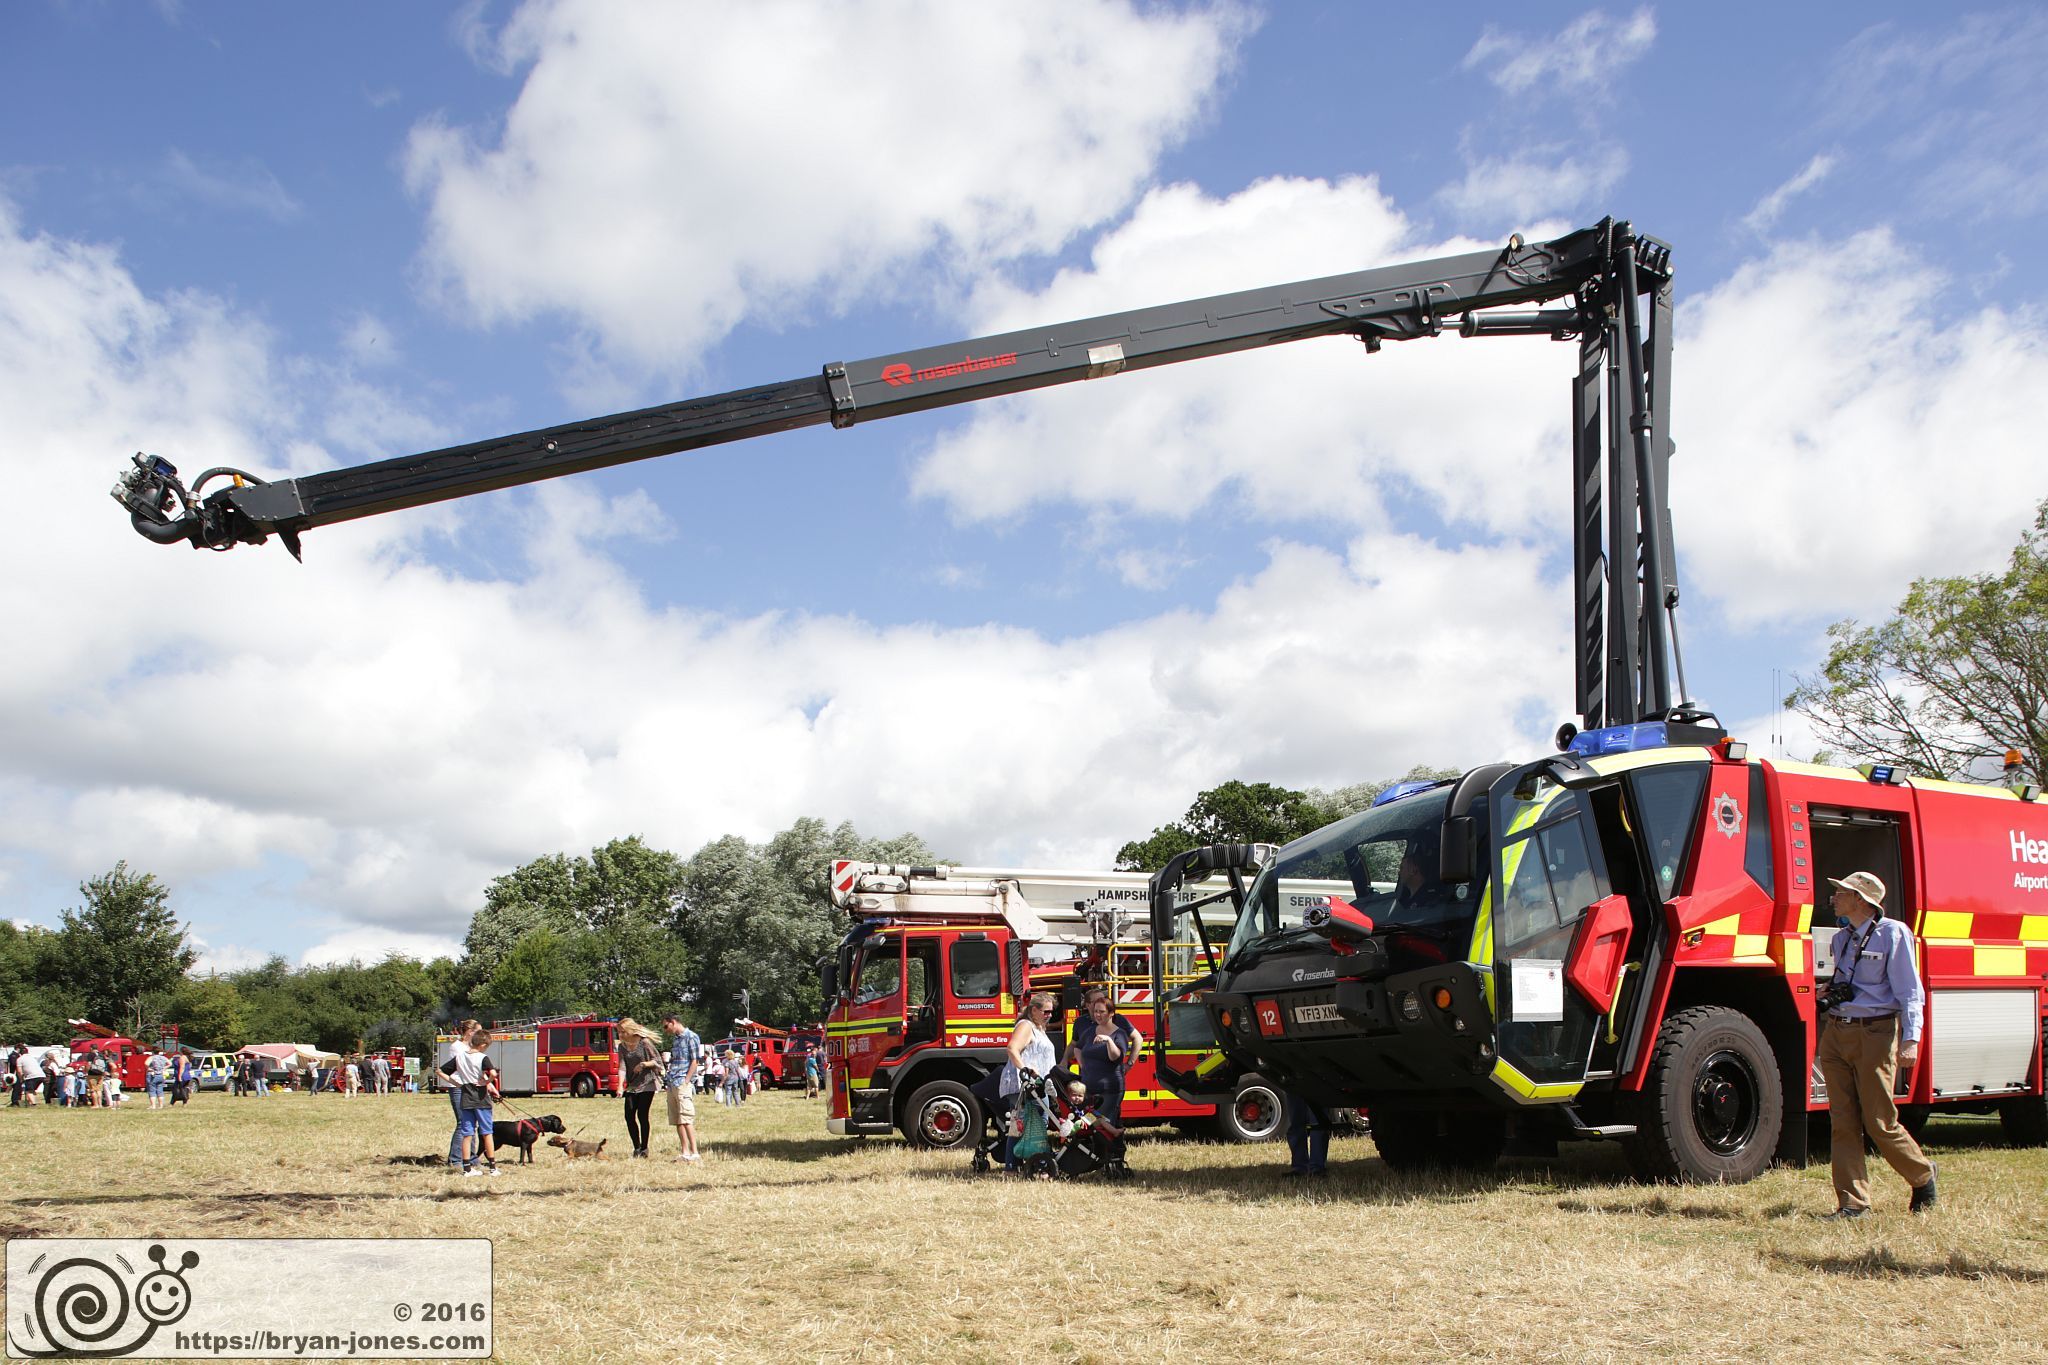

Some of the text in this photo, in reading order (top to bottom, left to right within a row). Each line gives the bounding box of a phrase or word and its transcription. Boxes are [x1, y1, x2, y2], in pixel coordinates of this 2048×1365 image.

[916, 352, 1018, 382] rosenbauer
[2009, 829, 2048, 865] Hea
[2013, 872, 2048, 893] Airport
[1097, 889, 1151, 901] HAMPSHI
[1303, 968, 1336, 980] rosenba
[1262, 1010, 1277, 1026] 12
[1300, 1007, 1321, 1021] YF13
[969, 1036, 1008, 1044] @hants_fire
